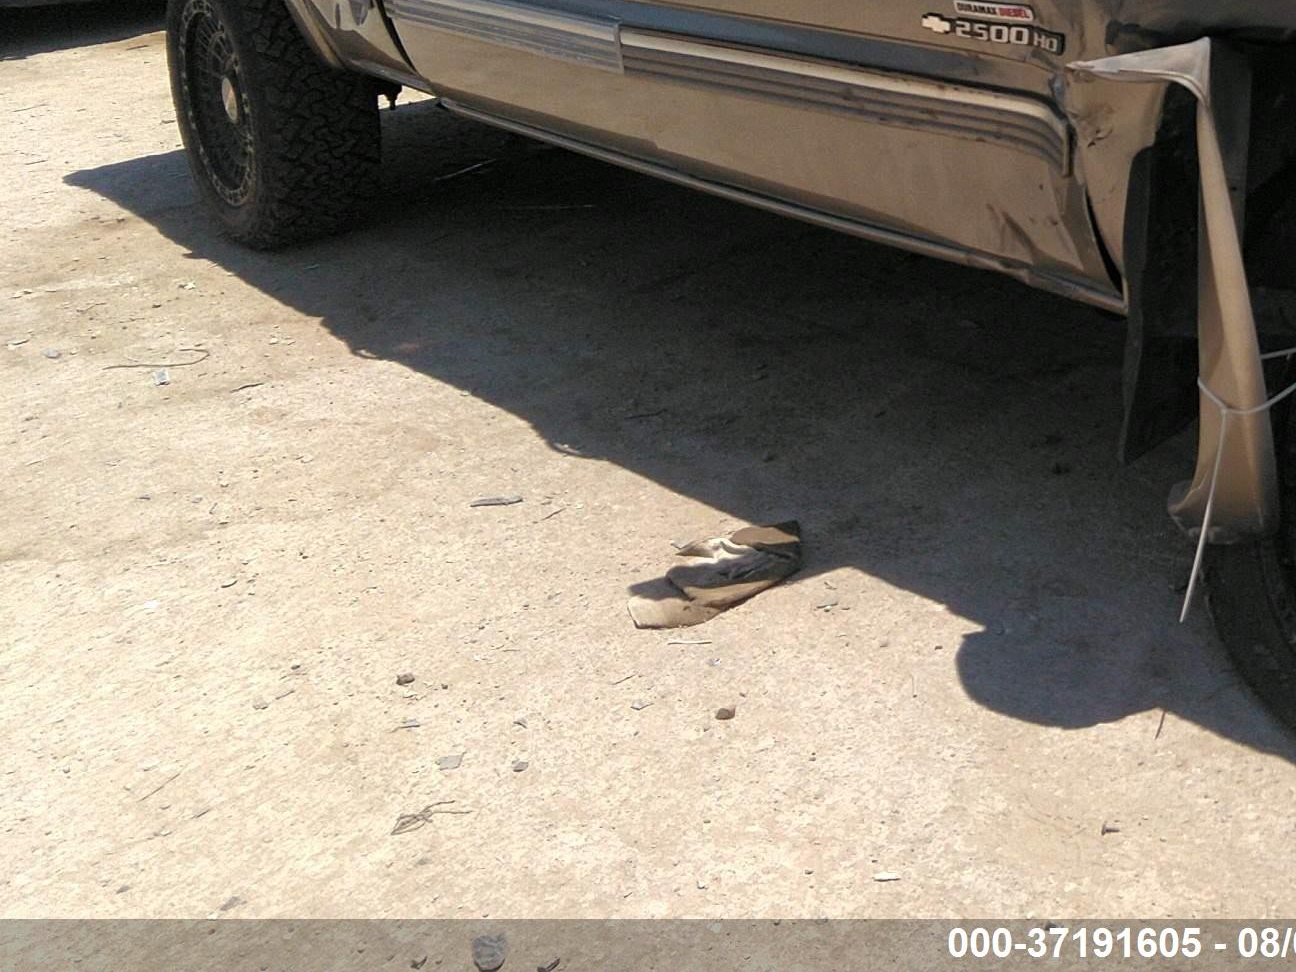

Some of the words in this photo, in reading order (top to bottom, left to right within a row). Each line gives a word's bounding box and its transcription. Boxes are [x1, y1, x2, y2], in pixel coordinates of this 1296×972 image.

[956, 3, 997, 15] DURAMAX
[955, 20, 1029, 45] 2500
[1033, 31, 1058, 52] HD
